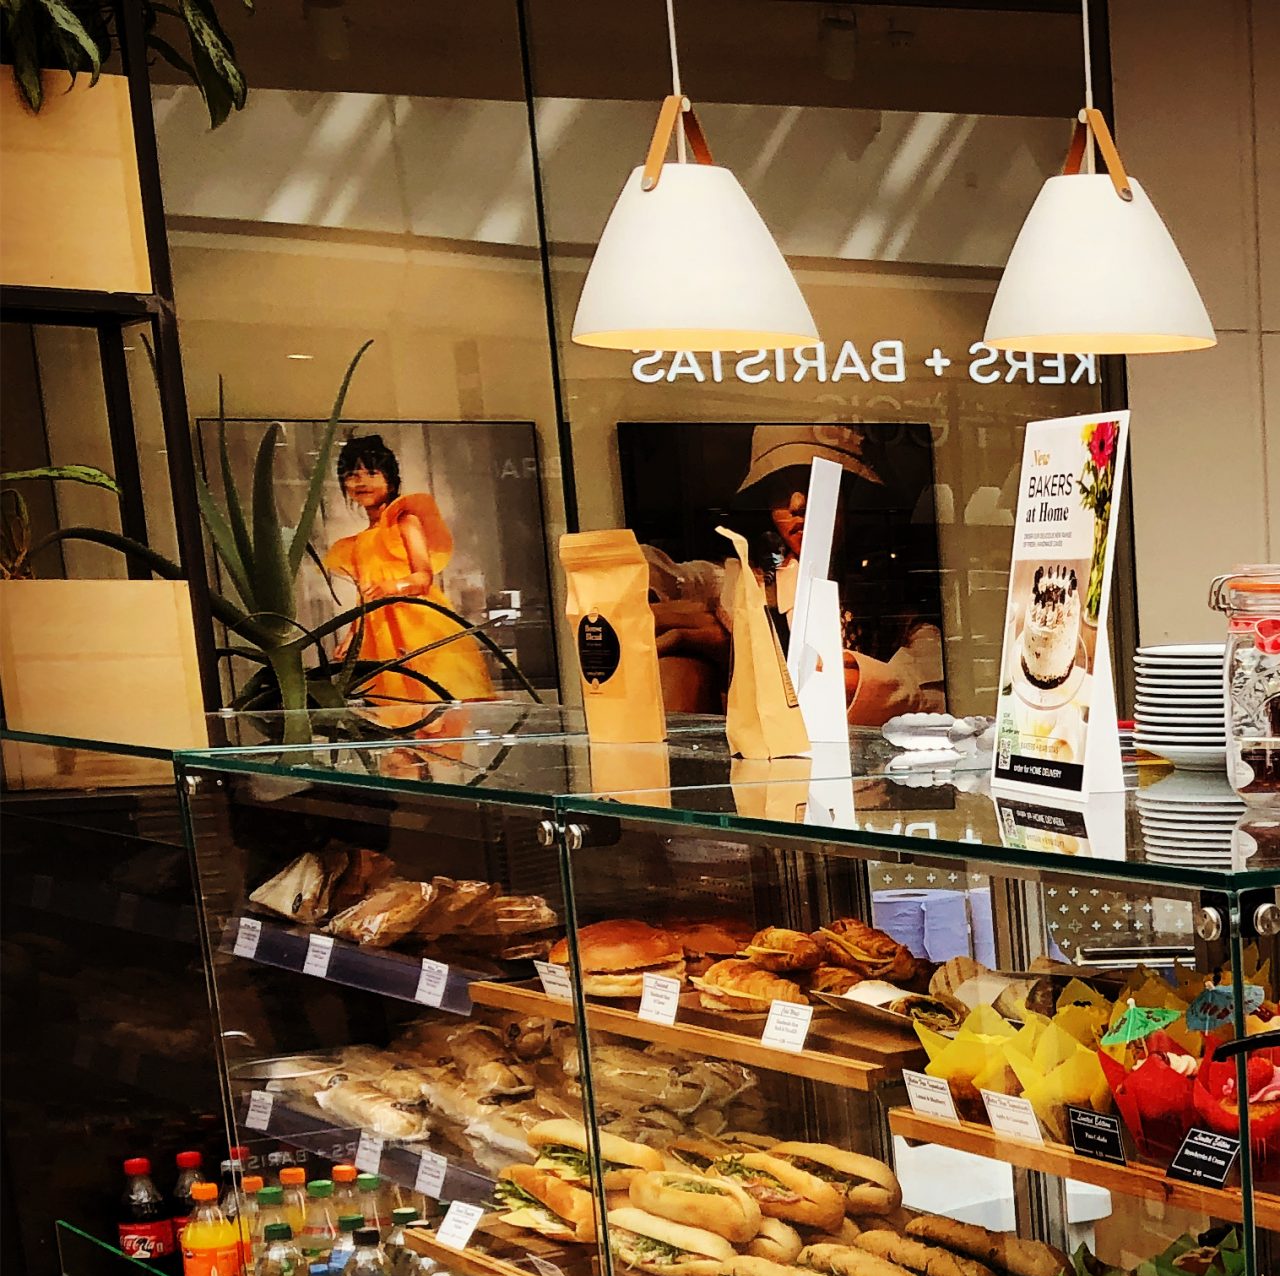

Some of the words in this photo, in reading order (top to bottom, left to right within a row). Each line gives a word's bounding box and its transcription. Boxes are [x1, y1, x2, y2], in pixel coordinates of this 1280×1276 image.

[1028, 473, 1073, 498] BAKERS
[1025, 507, 1037, 523] at
[1039, 502, 1069, 522] Home
[1030, 766, 1042, 776] HOME
[1211, 1156, 1226, 1166] Cream
